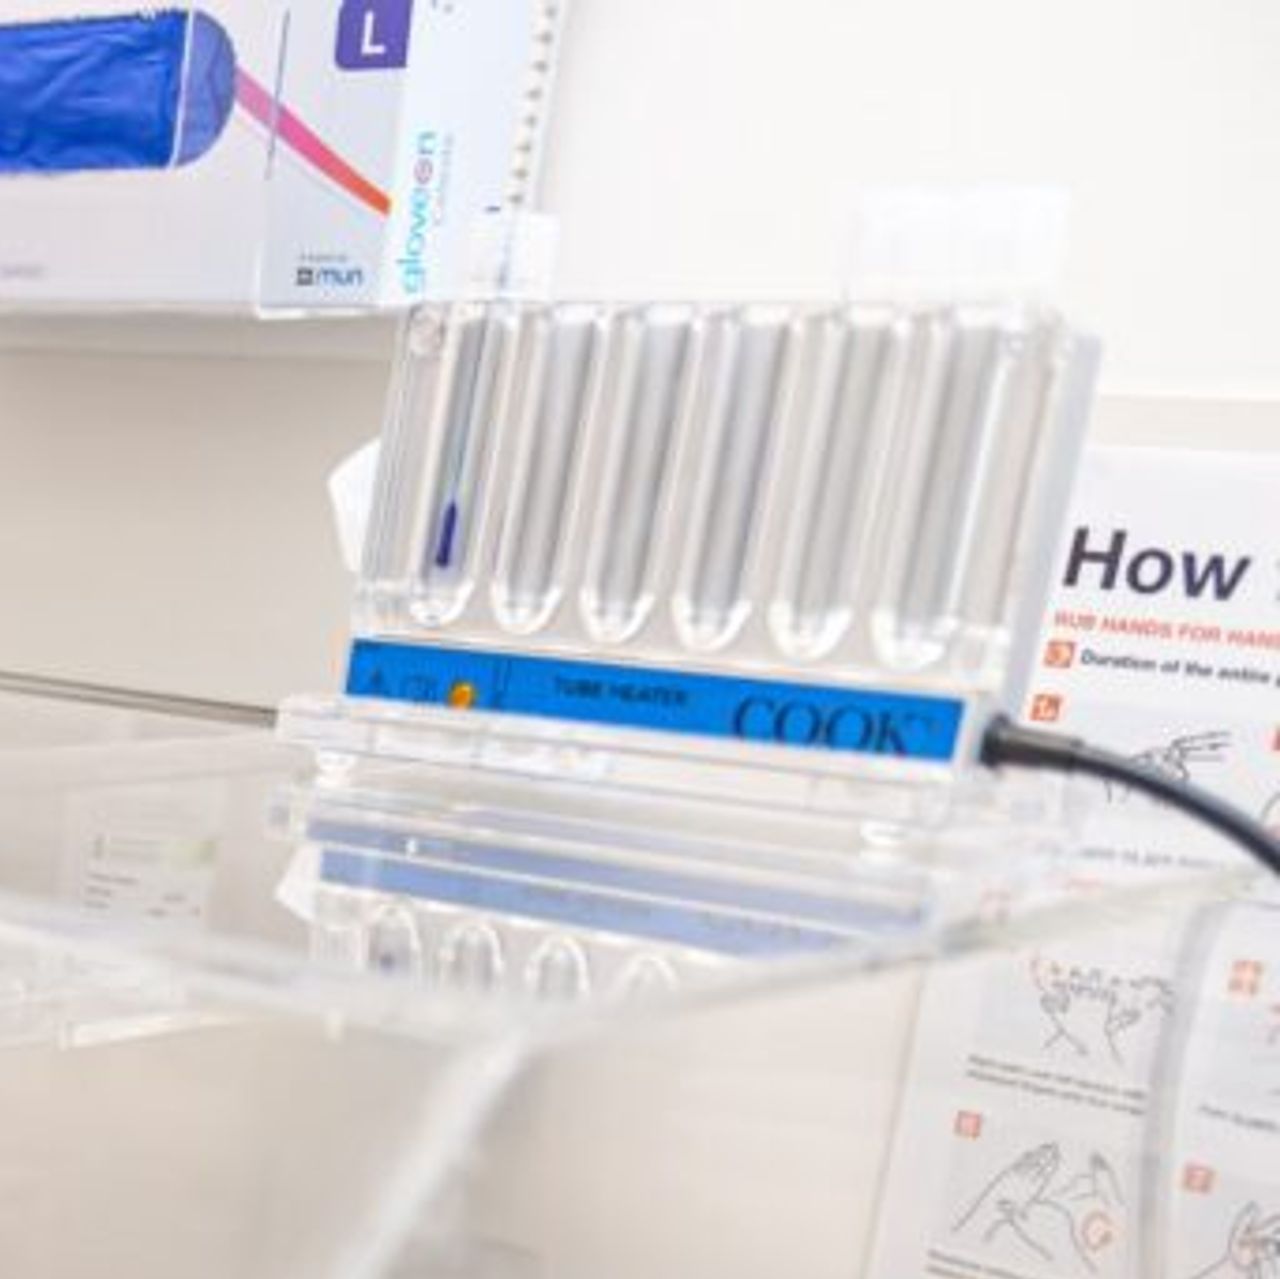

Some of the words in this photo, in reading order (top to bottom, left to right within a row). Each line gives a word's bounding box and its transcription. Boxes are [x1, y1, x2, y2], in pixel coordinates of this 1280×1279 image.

[361, 10, 386, 55] L
[1062, 525, 1252, 601] How
[732, 695, 937, 758] COOK
